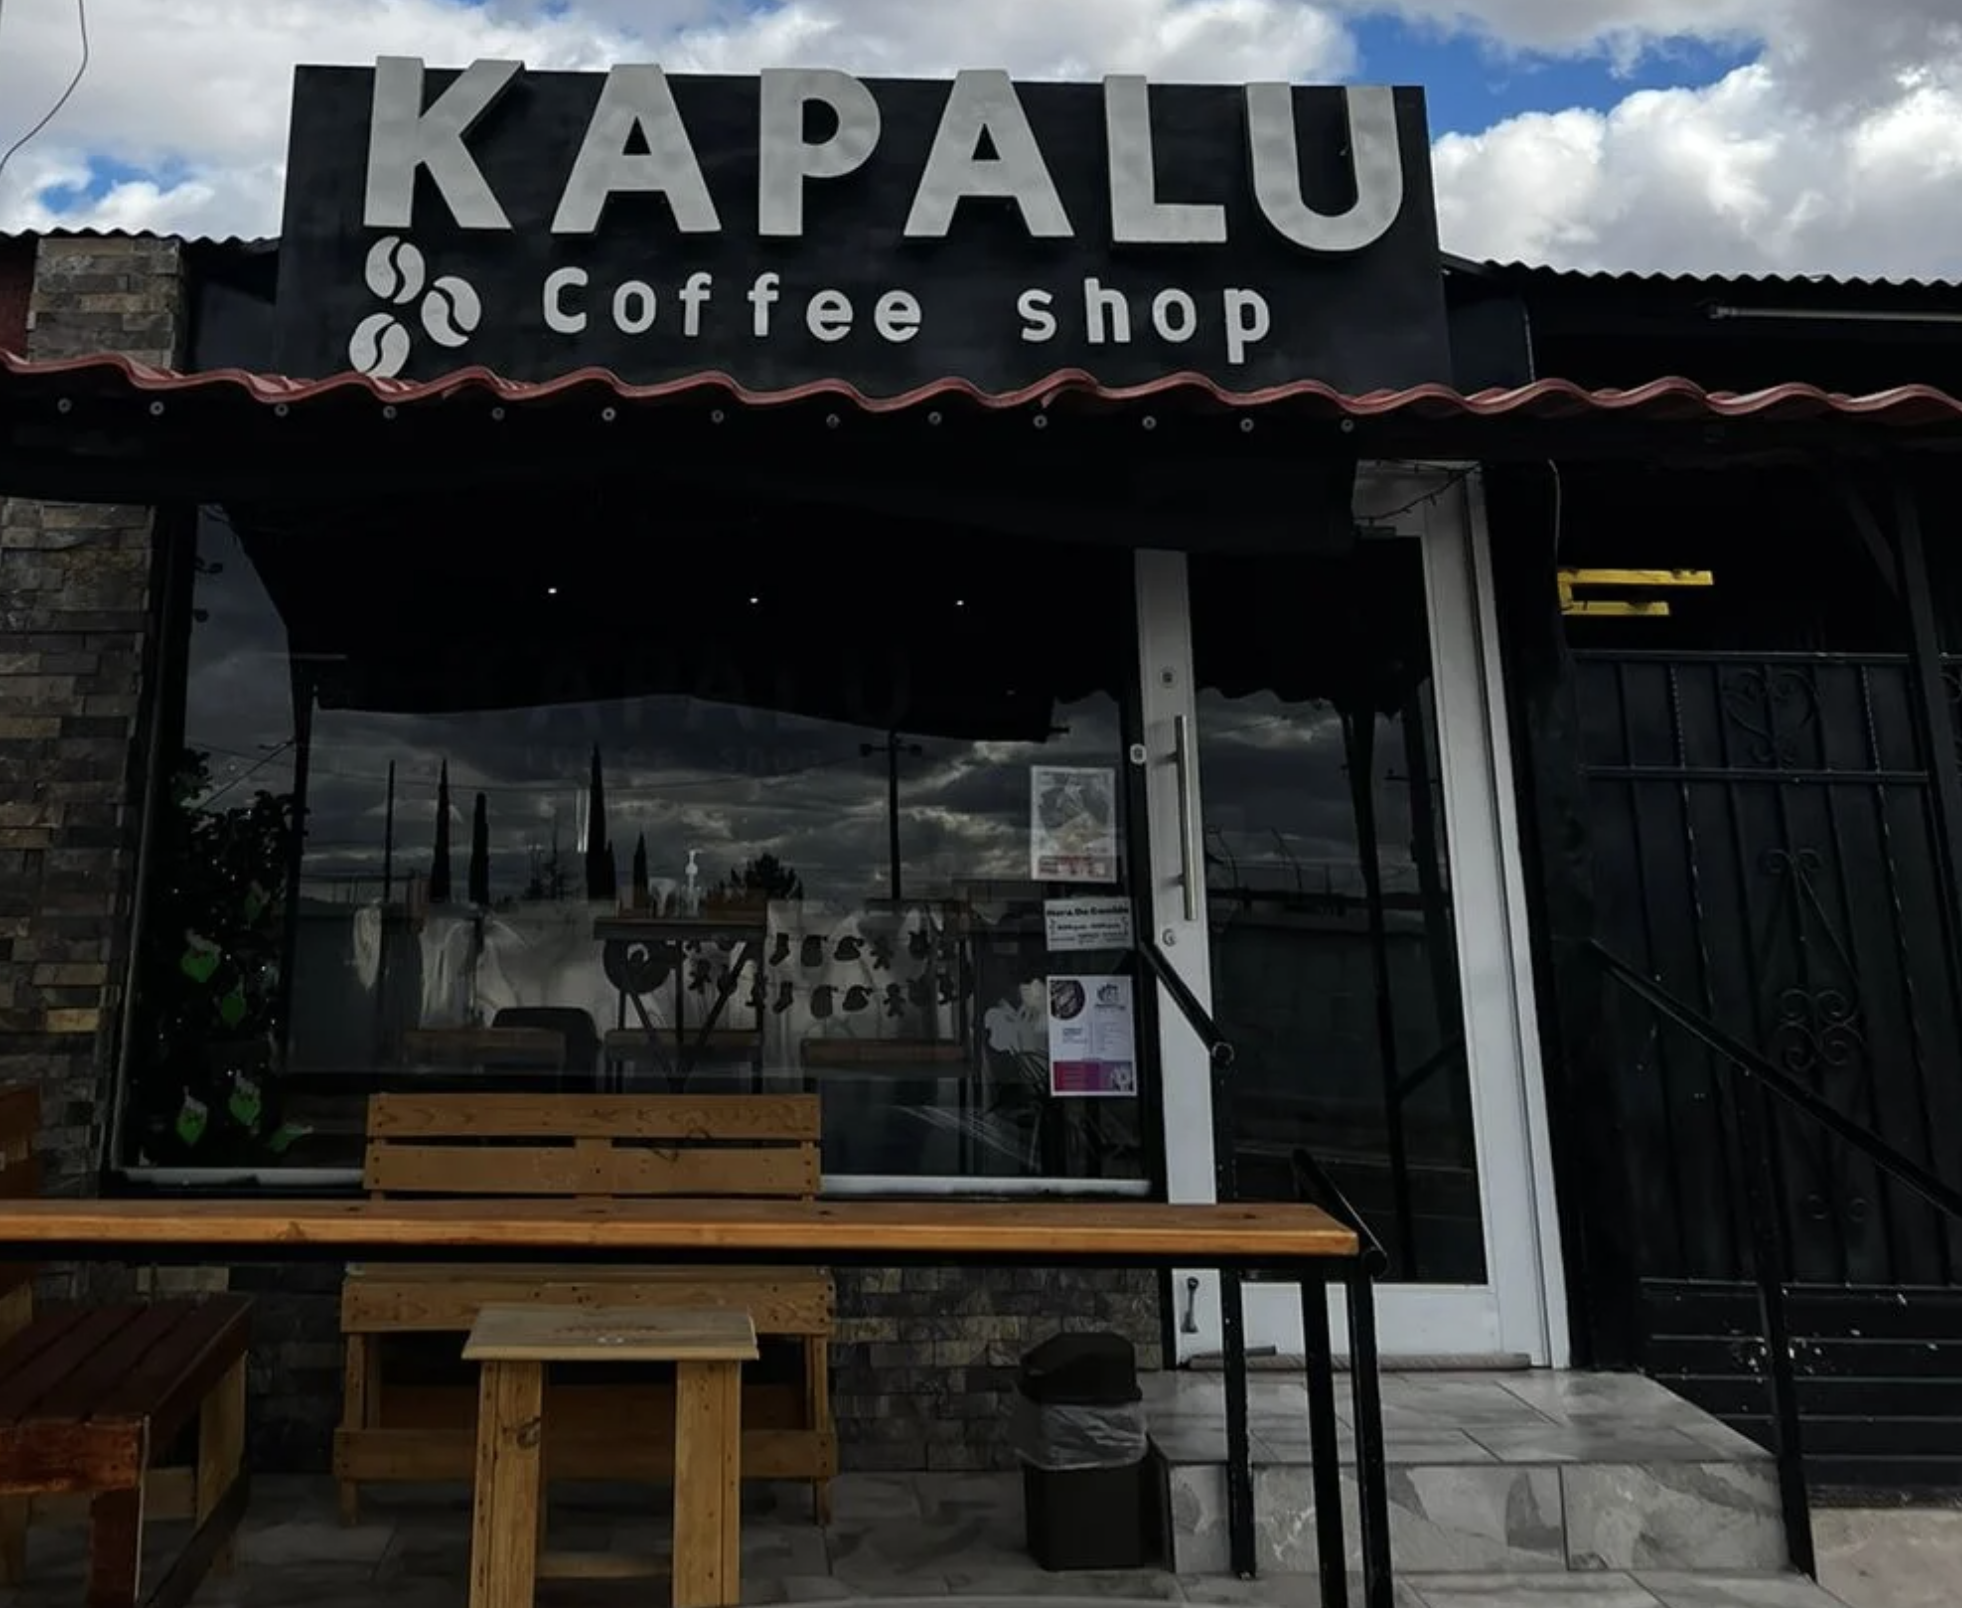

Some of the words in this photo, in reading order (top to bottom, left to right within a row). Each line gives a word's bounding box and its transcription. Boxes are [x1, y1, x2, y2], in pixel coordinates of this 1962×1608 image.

[364, 56, 1403, 251] KAPALU
[543, 266, 922, 342] Coffee
[1017, 277, 1271, 364] shop
